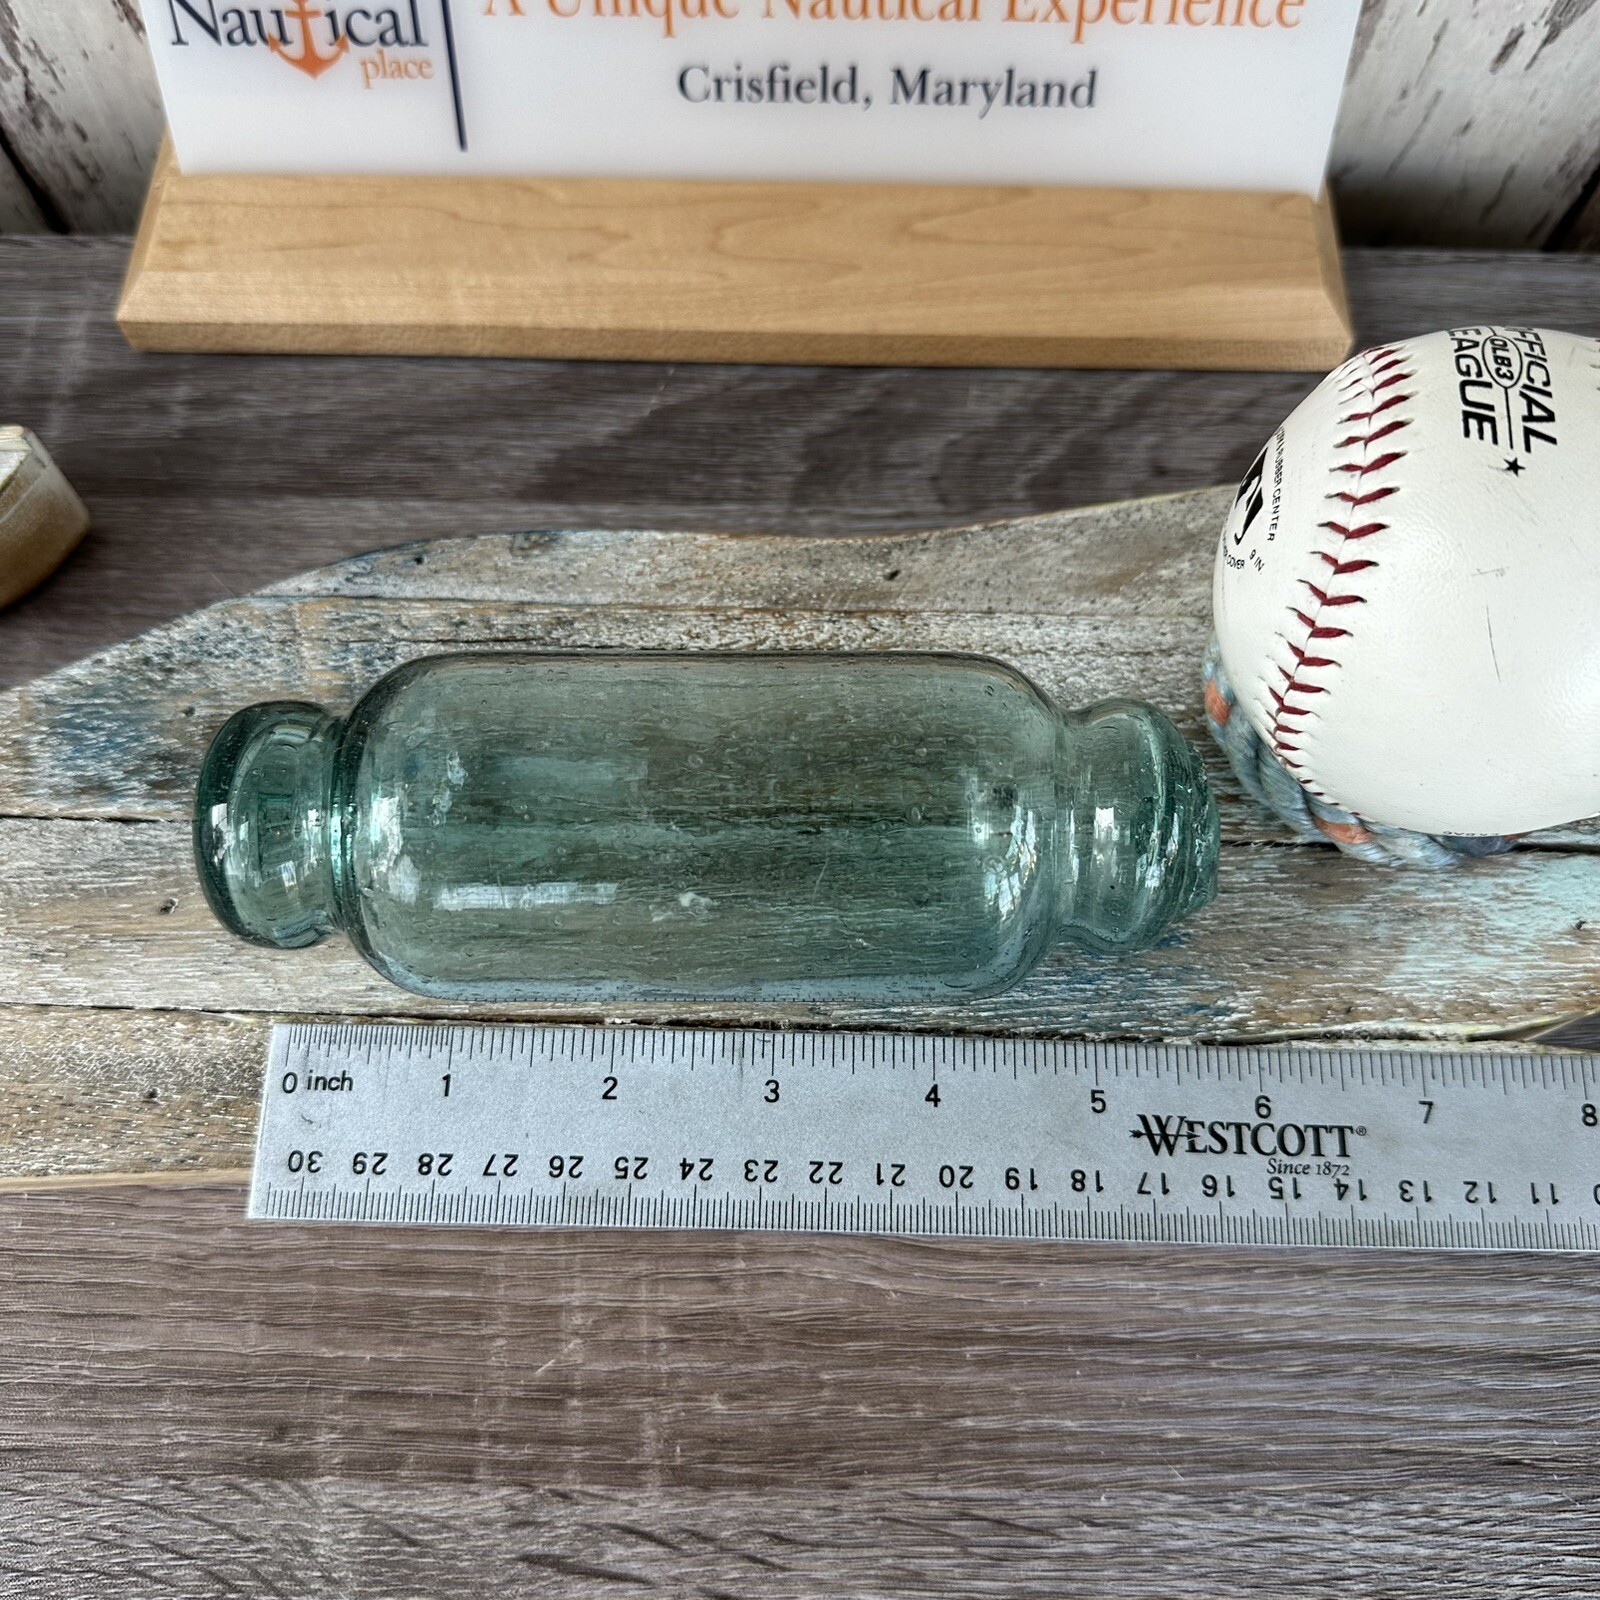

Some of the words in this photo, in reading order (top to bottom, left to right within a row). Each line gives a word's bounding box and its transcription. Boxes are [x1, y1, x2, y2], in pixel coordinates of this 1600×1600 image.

[360, 49, 434, 89] place
[679, 64, 873, 111] Crisfield,
[890, 67, 1097, 119] Maryland
[1490, 338, 1514, 381] OLB3
[1448, 328, 1499, 446] EAGUE
[1505, 327, 1557, 454] FFICIAL
[1267, 488, 1281, 541] CENTER
[282, 1072, 298, 1093] 0
[306, 1070, 354, 1092] inch
[442, 1074, 452, 1097] 1
[602, 1077, 618, 1100] 2
[764, 1080, 780, 1103] 3
[924, 1084, 942, 1107] 4
[1090, 1089, 1107, 1114] 5
[1255, 1095, 1272, 1119] 6
[1418, 1101, 1434, 1124] 7
[1581, 1103, 1598, 1127] 8
[288, 1151, 323, 1173] 30
[352, 1152, 388, 1175] 29
[418, 1153, 453, 1176] 28
[483, 1154, 518, 1177] 27
[549, 1156, 583, 1178] 26
[615, 1157, 648, 1180] 25
[680, 1158, 714, 1180] 24
[744, 1160, 778, 1182] 23
[809, 1161, 843, 1184] 22
[1266, 1158, 1311, 1175] Since
[1316, 1161, 1350, 1179] 1872
[876, 1163, 906, 1186] 21
[939, 1165, 973, 1188] 20
[1005, 1168, 1038, 1191] 19
[1071, 1170, 1104, 1193] 18
[1137, 1172, 1170, 1195] 17
[1202, 1175, 1235, 1197] 16
[1268, 1176, 1302, 1199] 15
[1333, 1178, 1368, 1201] 14
[1399, 1180, 1433, 1202] 13
[1463, 1181, 1497, 1203] 12
[1531, 1183, 1559, 1205] 11
